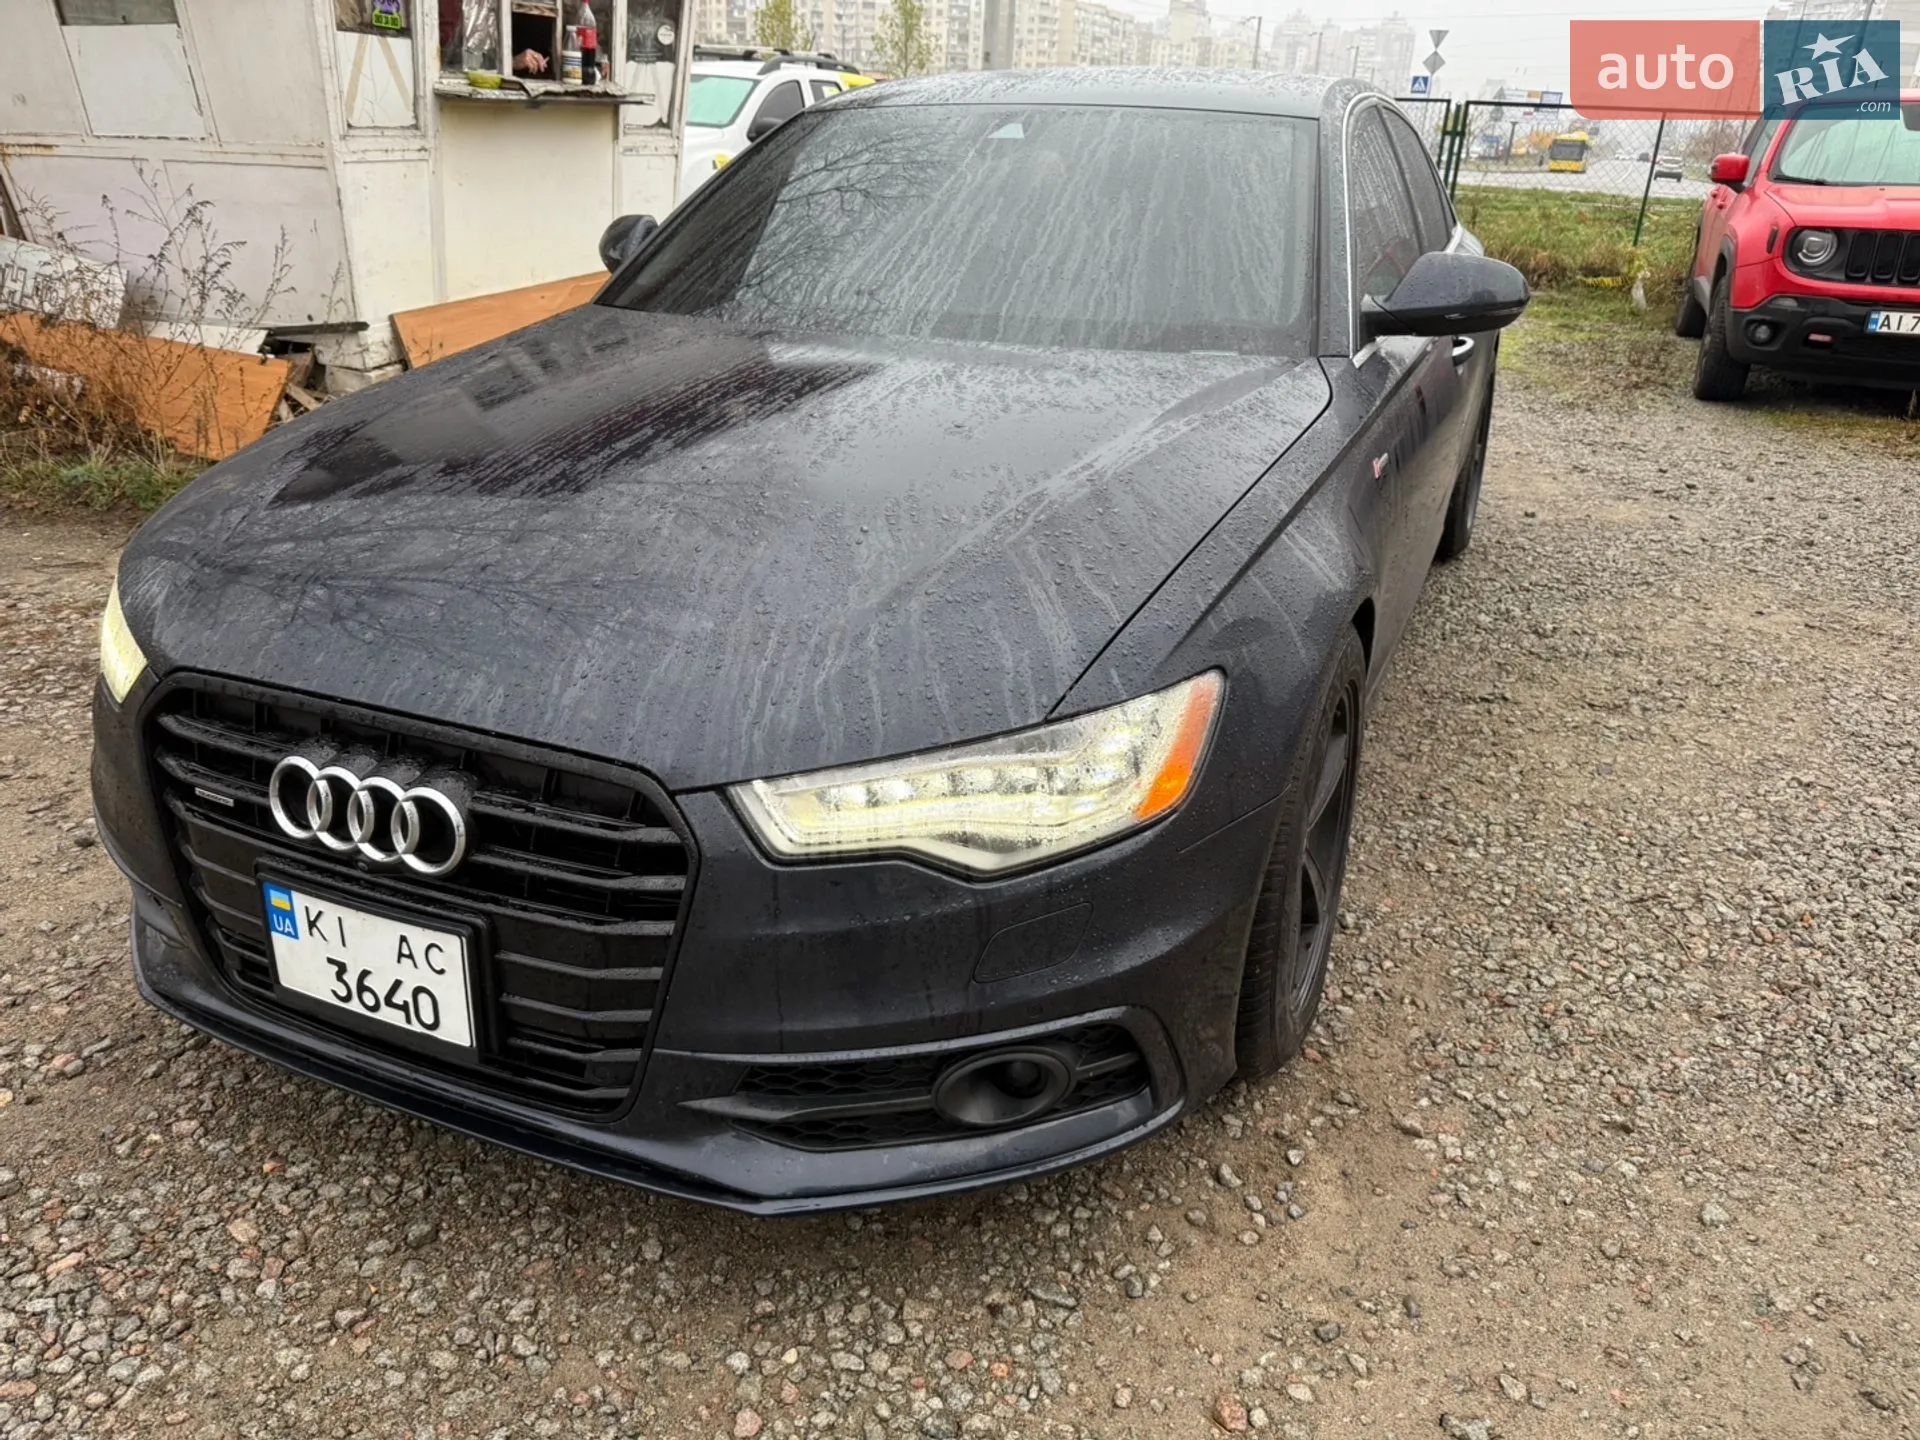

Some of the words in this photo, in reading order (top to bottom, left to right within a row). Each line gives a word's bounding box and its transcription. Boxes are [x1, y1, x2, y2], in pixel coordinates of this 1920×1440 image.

[1879, 314, 1903, 331] AI
[272, 913, 296, 937] UA
[304, 905, 349, 948] KI
[397, 934, 446, 976] AC
[326, 956, 441, 1032] 3640
